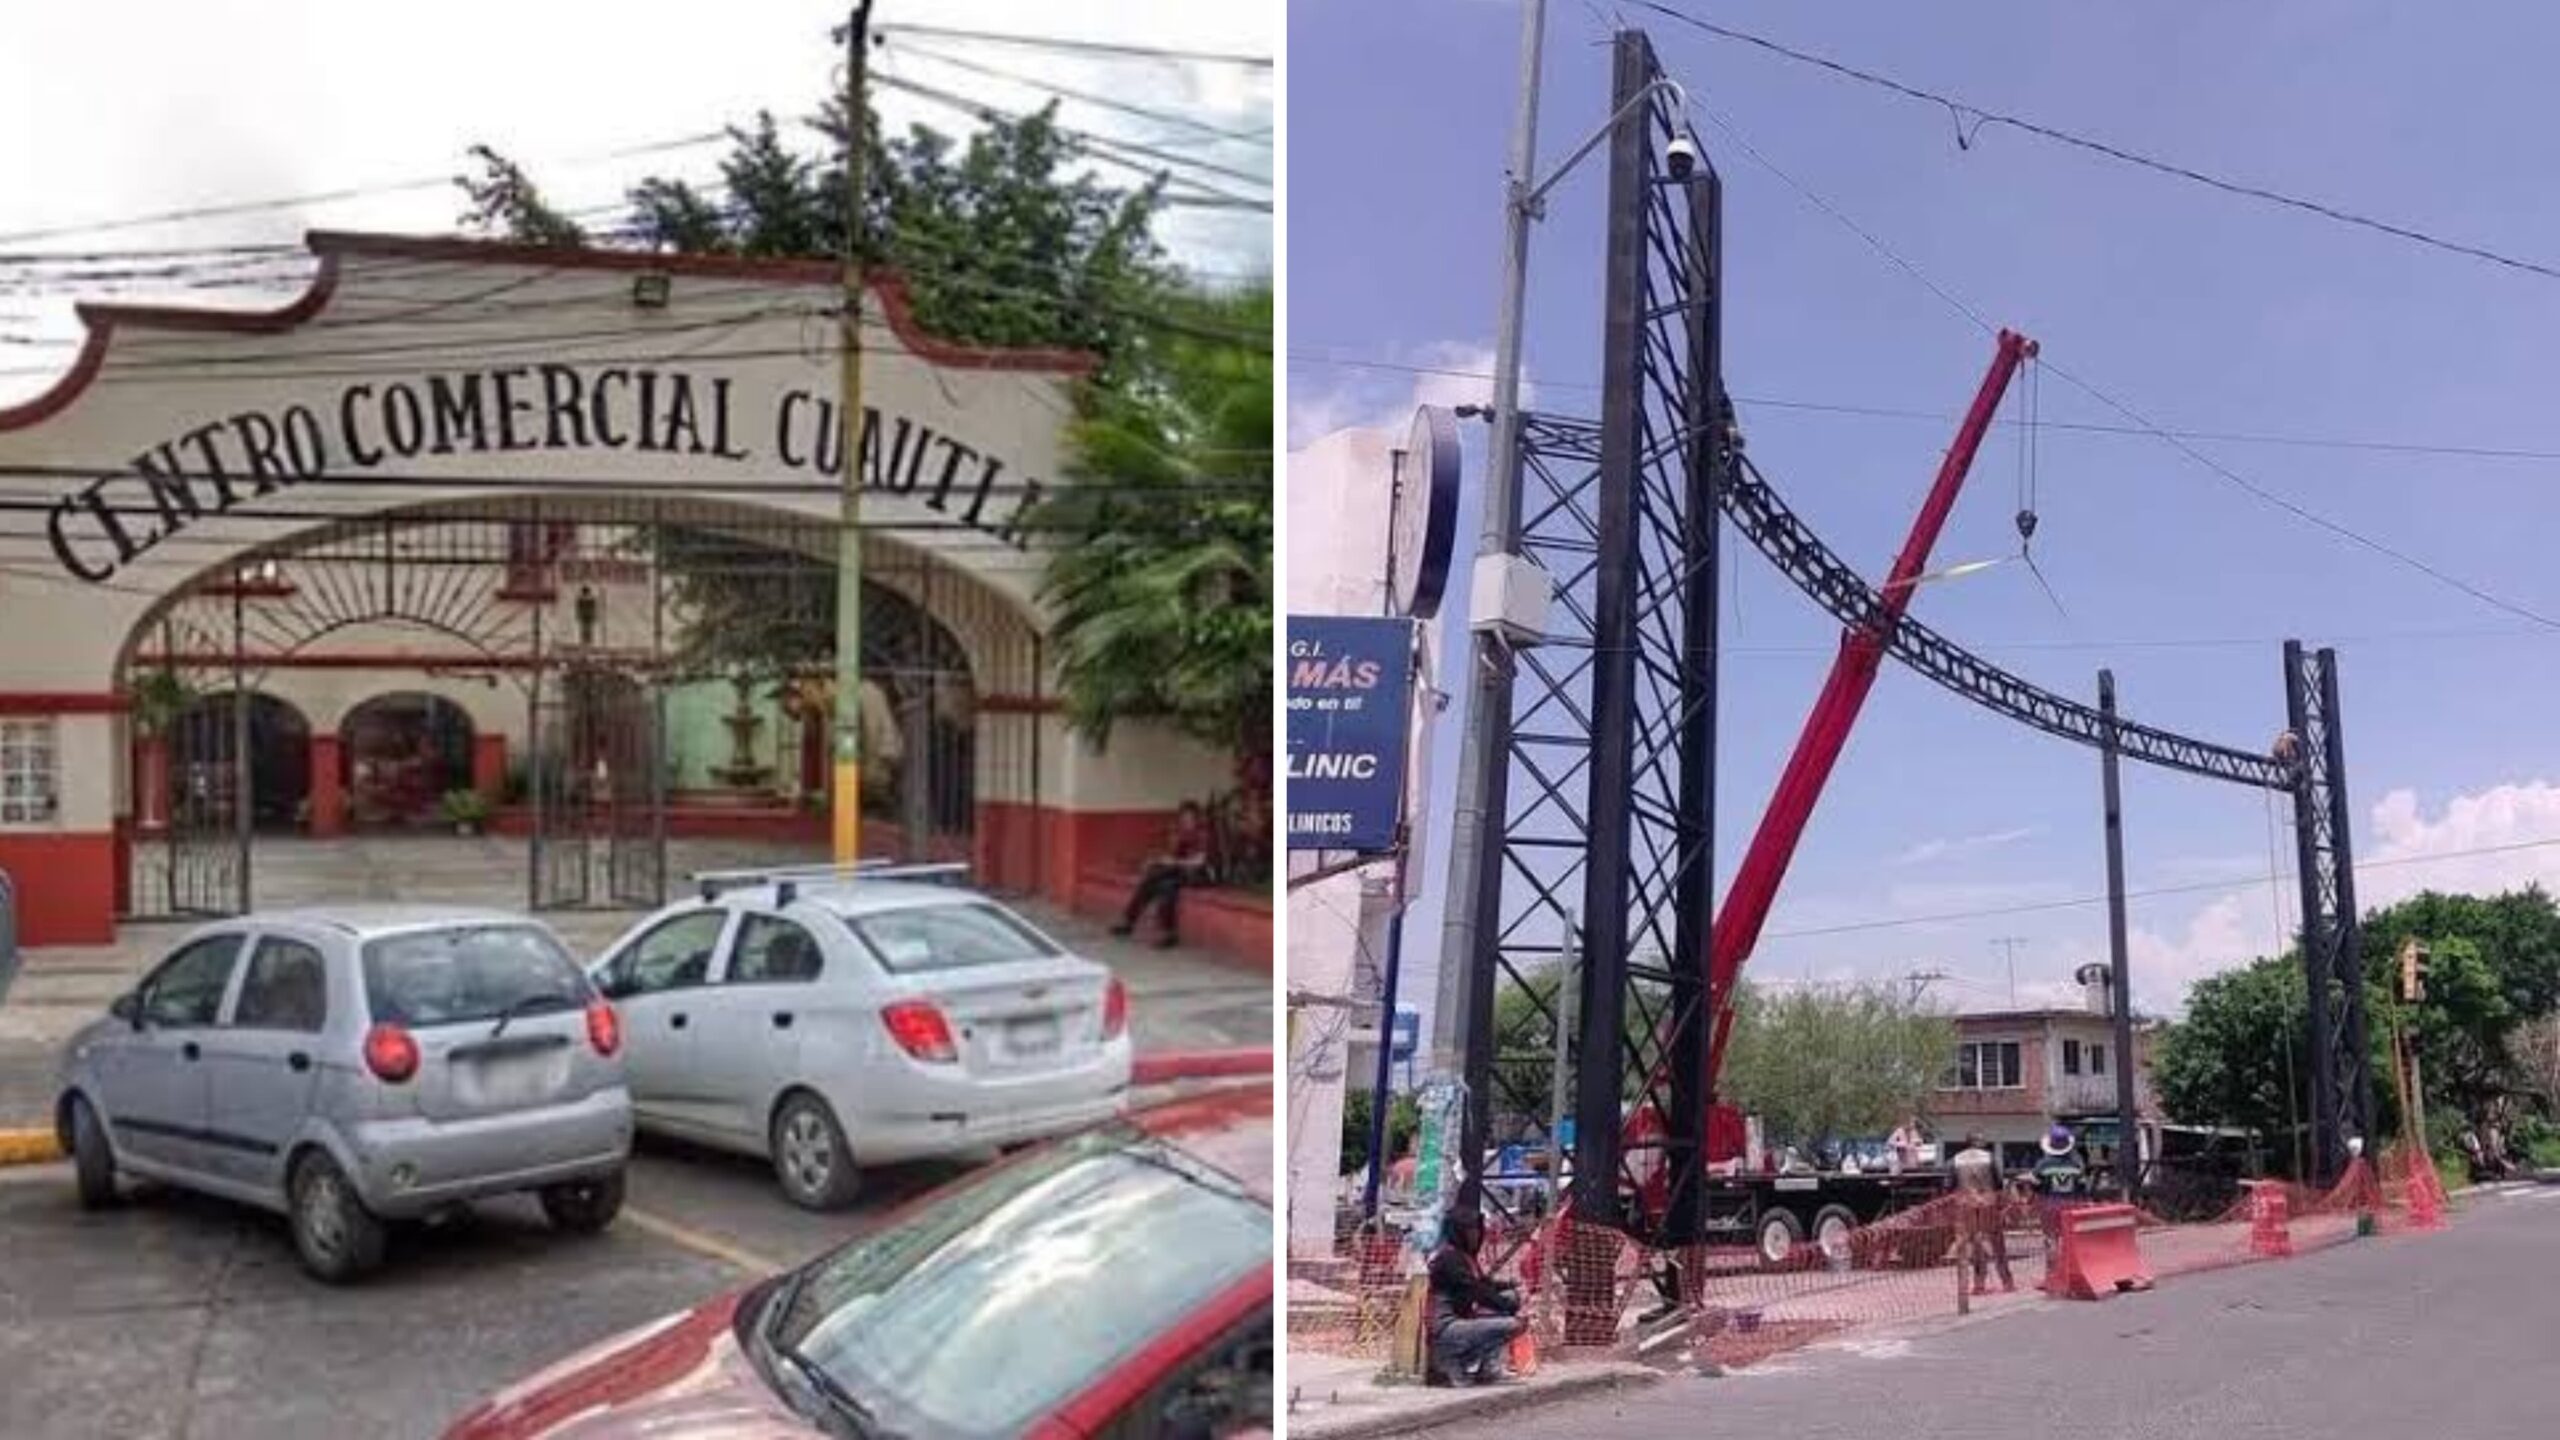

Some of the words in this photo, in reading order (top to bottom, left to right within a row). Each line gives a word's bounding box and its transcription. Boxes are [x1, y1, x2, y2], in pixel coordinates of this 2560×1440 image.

[46, 401, 327, 583] CENTRO
[341, 362, 750, 468] COMERCIAL
[1292, 655, 1380, 689] MÁS
[1287, 753, 1377, 779] LINIC
